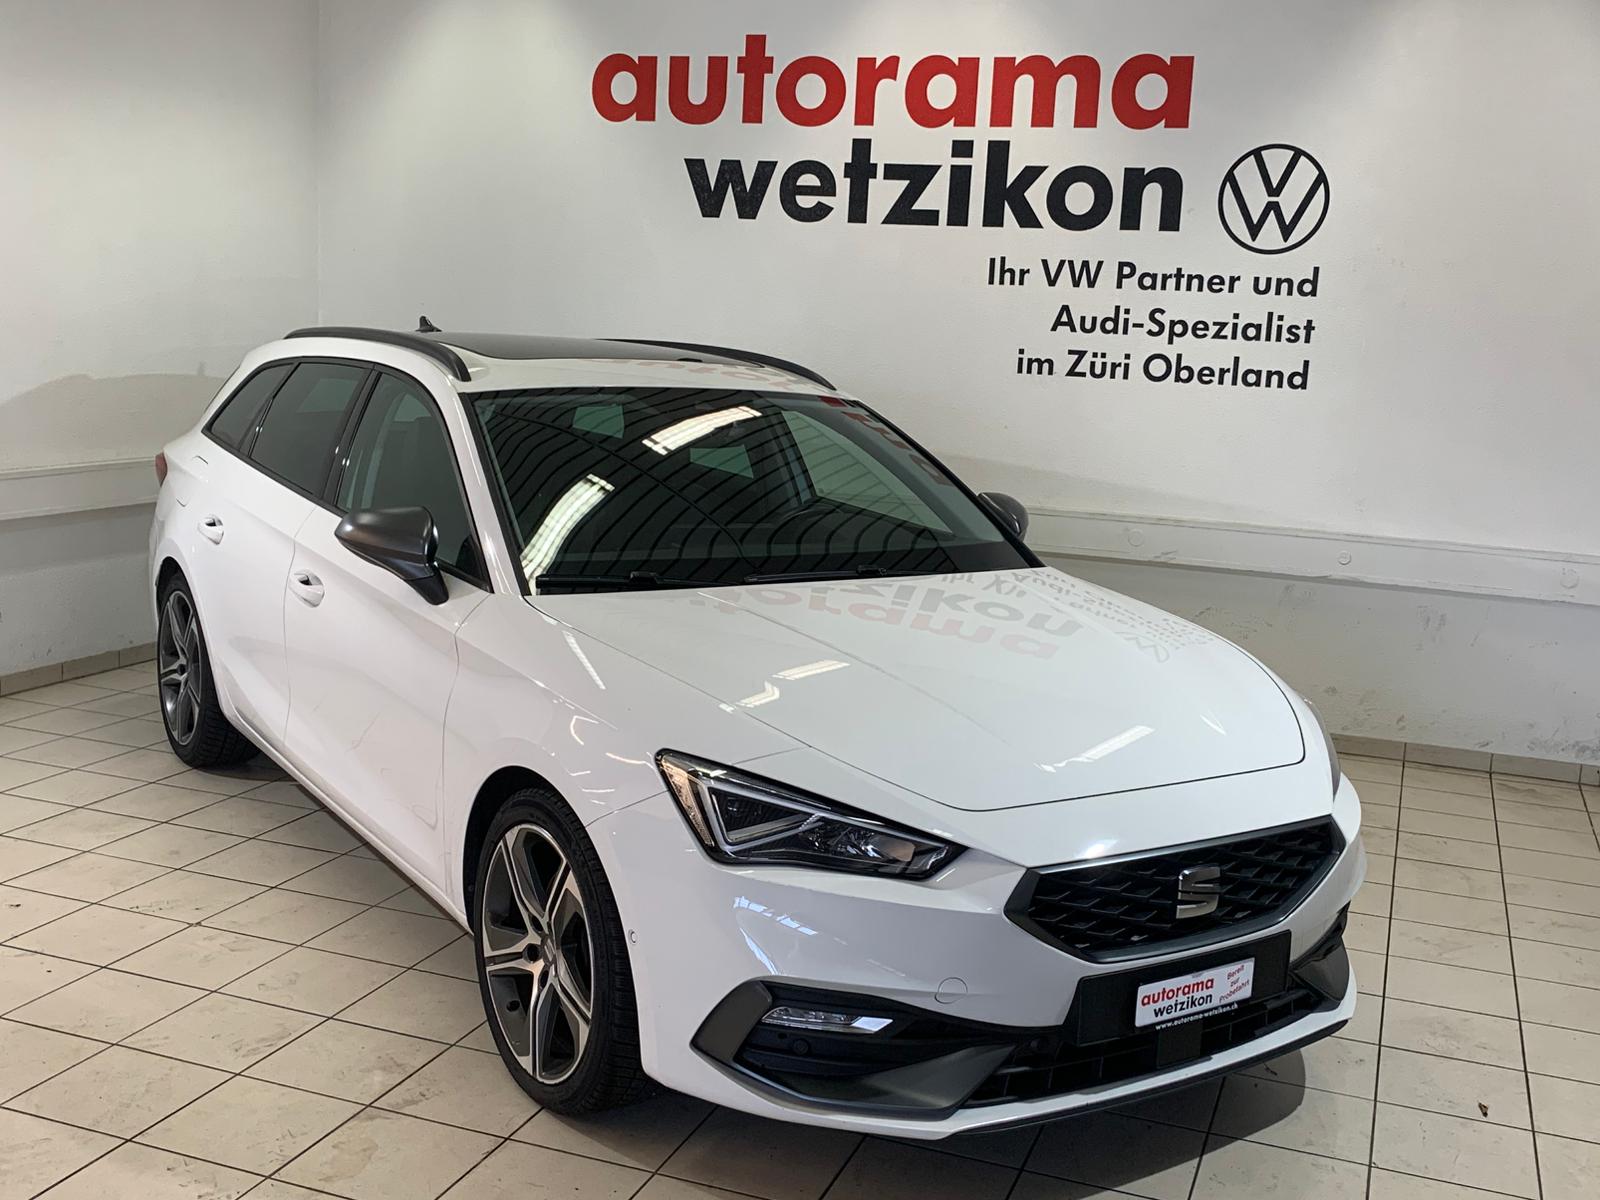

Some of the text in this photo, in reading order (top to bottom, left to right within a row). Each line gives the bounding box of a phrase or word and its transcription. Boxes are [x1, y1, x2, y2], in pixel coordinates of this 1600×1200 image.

[592, 35, 1194, 129] autorama
[684, 139, 1184, 232] wetzikon
[988, 257, 1320, 298] Ihr VW Partner und
[1051, 304, 1316, 346] Audi-Spezialist
[1017, 348, 1310, 390] im Züri Oberland
[1227, 964, 1245, 980] Bereit
[1230, 977, 1240, 987] zur
[1141, 977, 1215, 1007] autorama
[1153, 993, 1213, 1018] wetzikon
[1219, 979, 1250, 1004] Probefahrt
[1155, 1001, 1238, 1030] www.autorama-wetzikon.ch
